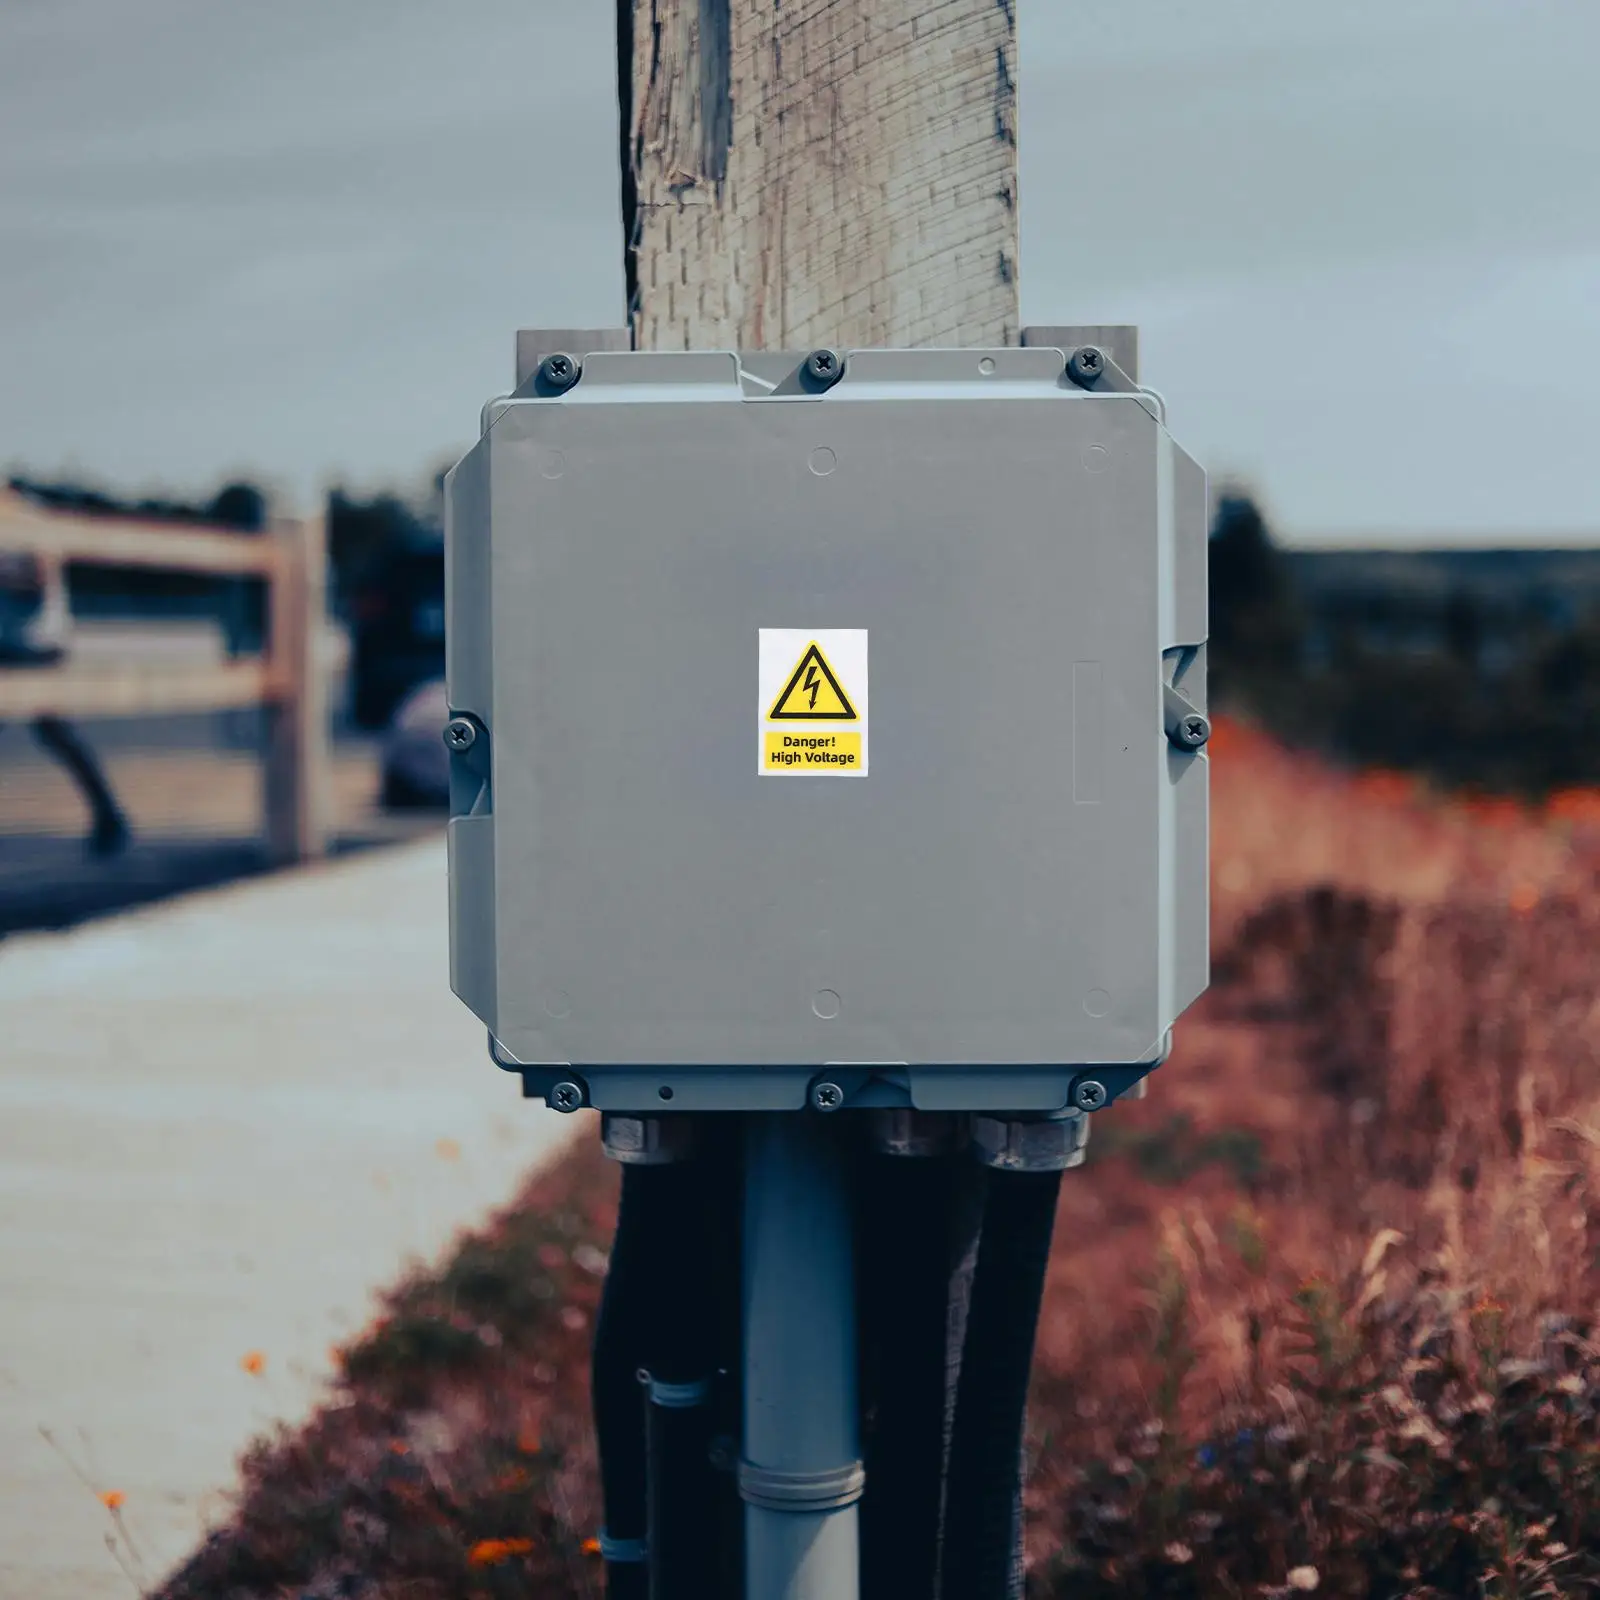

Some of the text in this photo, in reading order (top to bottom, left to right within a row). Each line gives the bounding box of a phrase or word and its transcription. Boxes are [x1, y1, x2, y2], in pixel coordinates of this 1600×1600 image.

[783, 736, 836, 750] Danger!
[771, 751, 855, 766] High Voltage
